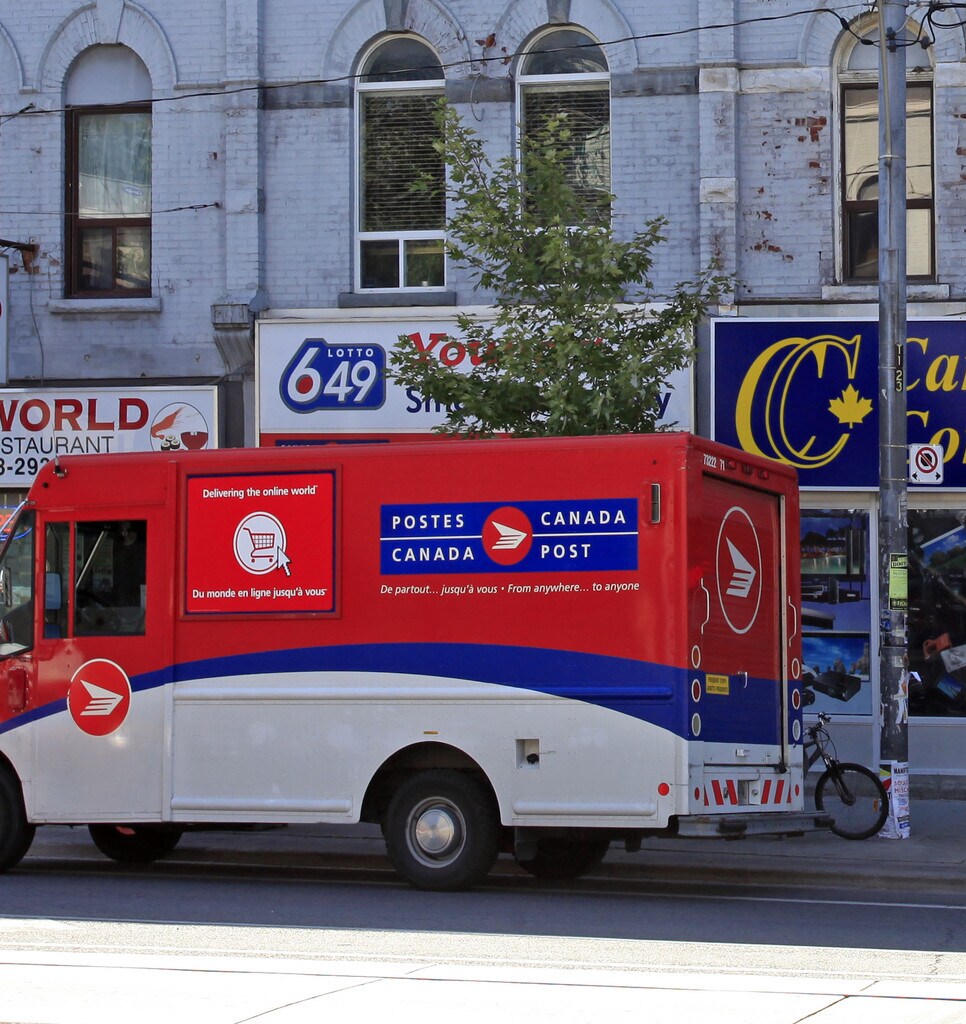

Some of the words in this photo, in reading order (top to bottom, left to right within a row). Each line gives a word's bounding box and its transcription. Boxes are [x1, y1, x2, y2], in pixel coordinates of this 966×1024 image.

[327, 347, 375, 358] LOTTO
[1, 436, 115, 455] STAURANT
[202, 488, 245, 499] Delivering
[247, 487, 261, 497] the
[263, 486, 289, 497] online
[392, 513, 465, 530] POSTES
[541, 510, 626, 526] CANADA
[392, 546, 475, 562] CANADA
[541, 543, 591, 559] POST
[192, 589, 205, 598] Du
[206, 588, 236, 598] monde
[238, 589, 249, 598] en
[251, 588, 271, 599] ligne
[380, 584, 394, 594] De
[394, 584, 439, 596] partout...
[476, 586, 498, 594] vous
[507, 584, 532, 593] From
[533, 583, 589, 595] anywhere...
[592, 583, 603, 592] to
[604, 582, 640, 594] anyone
